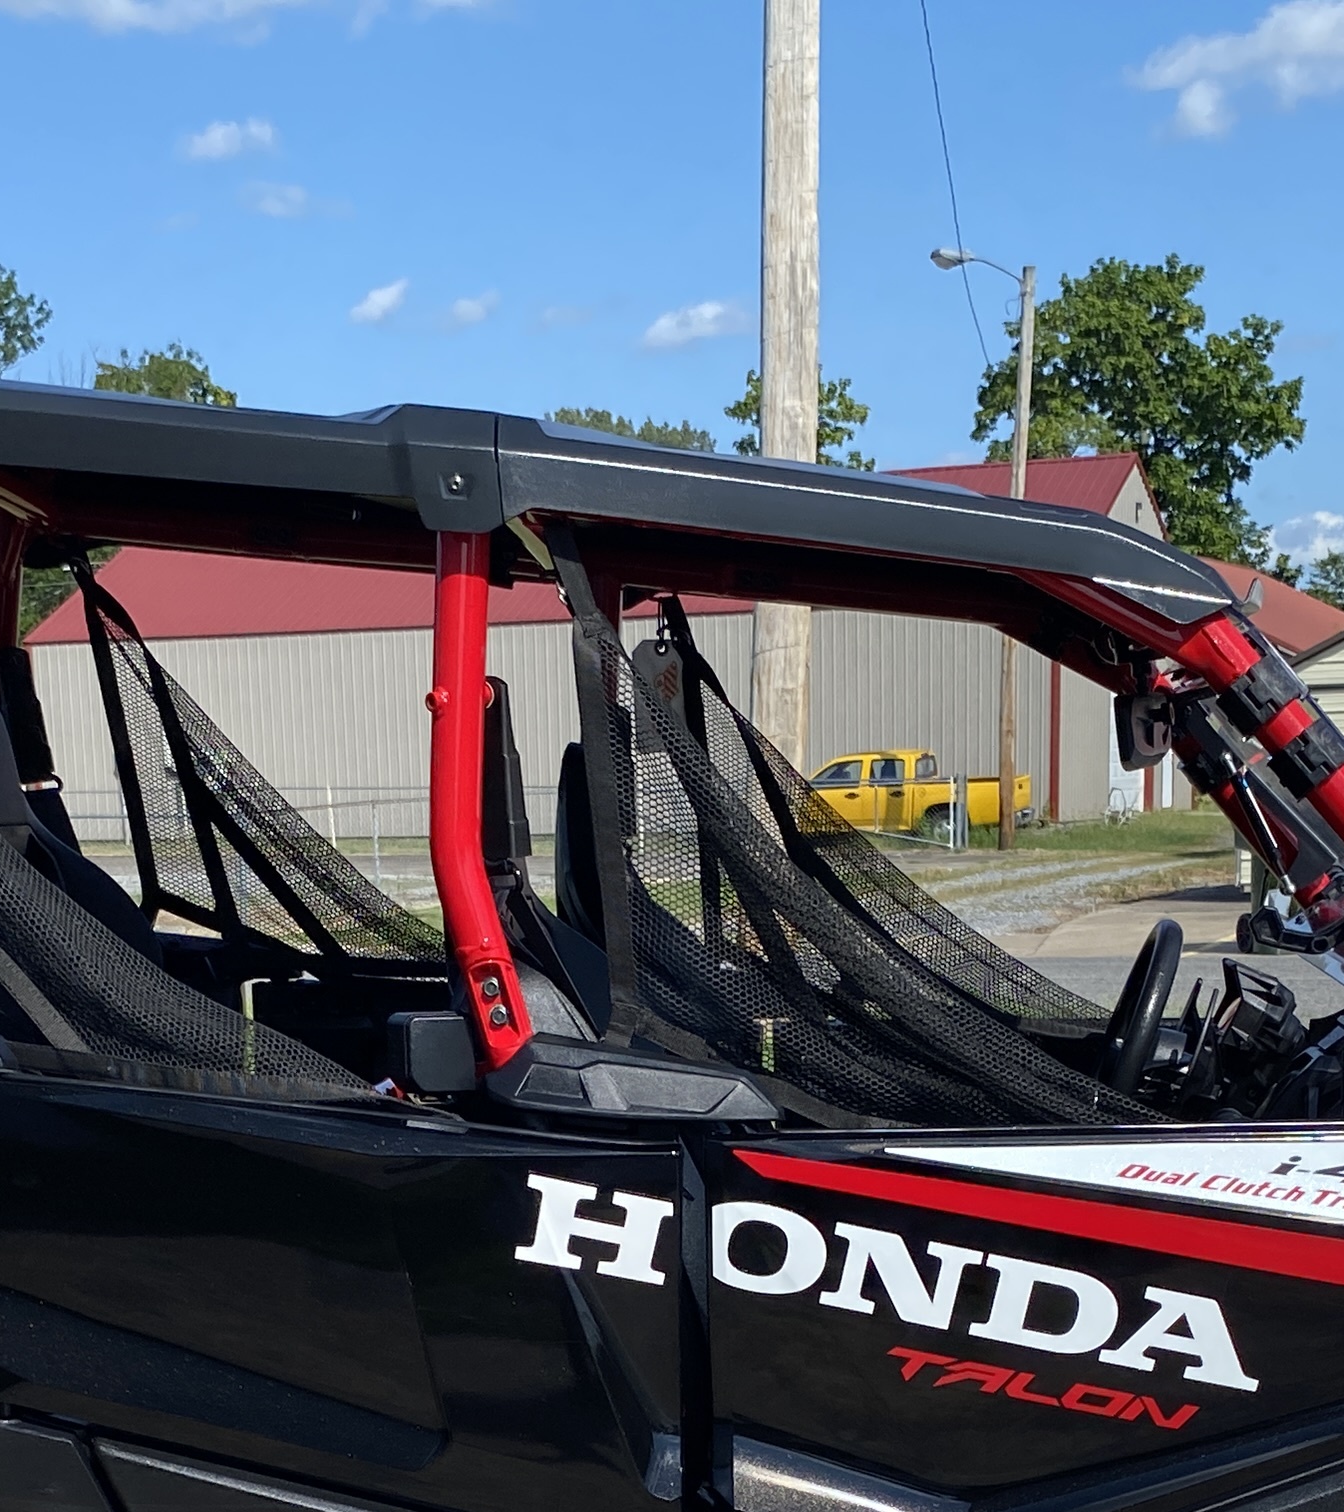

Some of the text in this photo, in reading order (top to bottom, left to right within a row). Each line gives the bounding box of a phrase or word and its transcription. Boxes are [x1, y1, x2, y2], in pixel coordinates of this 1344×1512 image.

[1116, 1163, 1199, 1188] Dual
[1200, 1174, 1306, 1203] Clutch
[513, 1170, 1259, 1392] HONDA
[886, 1345, 1200, 1430] TALON
